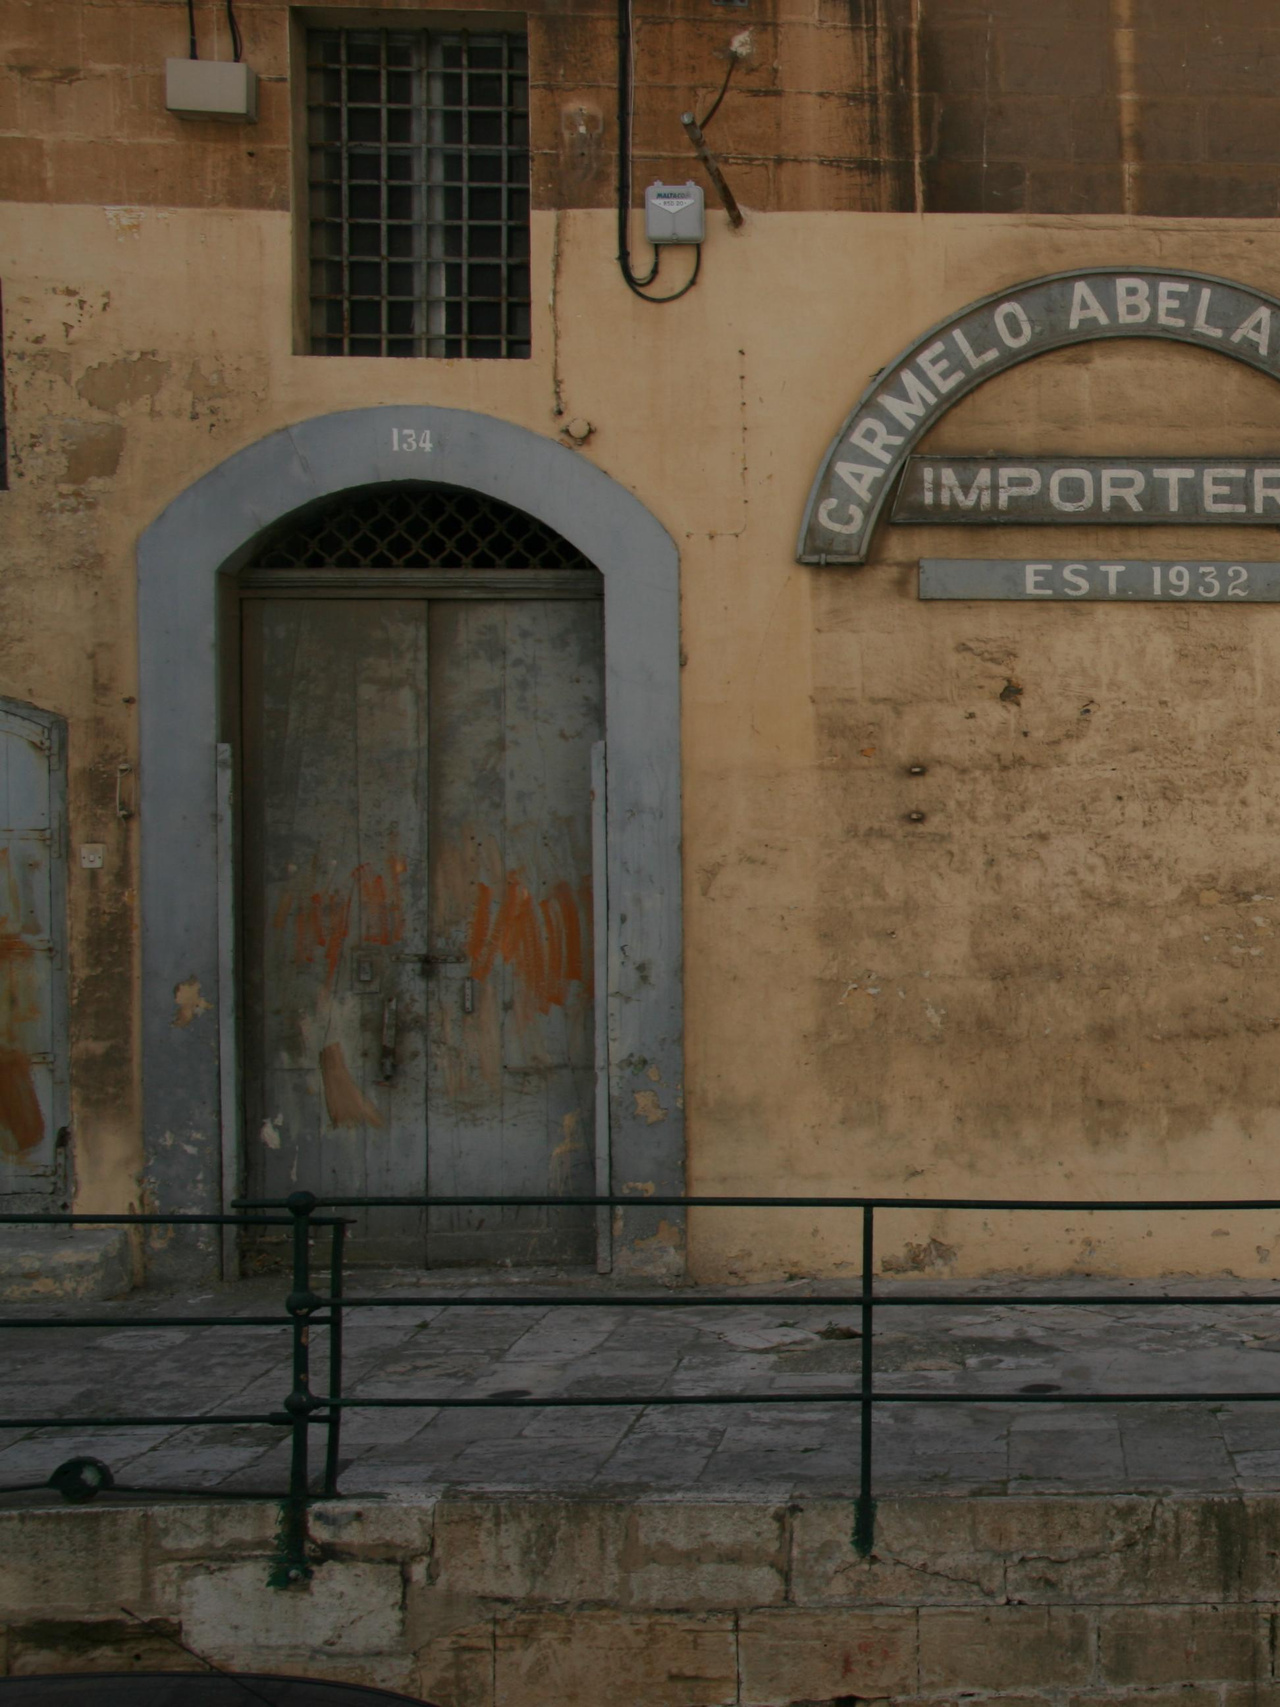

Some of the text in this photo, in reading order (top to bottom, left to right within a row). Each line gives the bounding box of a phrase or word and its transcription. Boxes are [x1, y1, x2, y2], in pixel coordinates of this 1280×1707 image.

[817, 300, 1032, 536] CARMELO
[1068, 277, 1271, 356] ABELA
[392, 428, 433, 452] 134
[1024, 564, 1249, 597] EST. 1932
